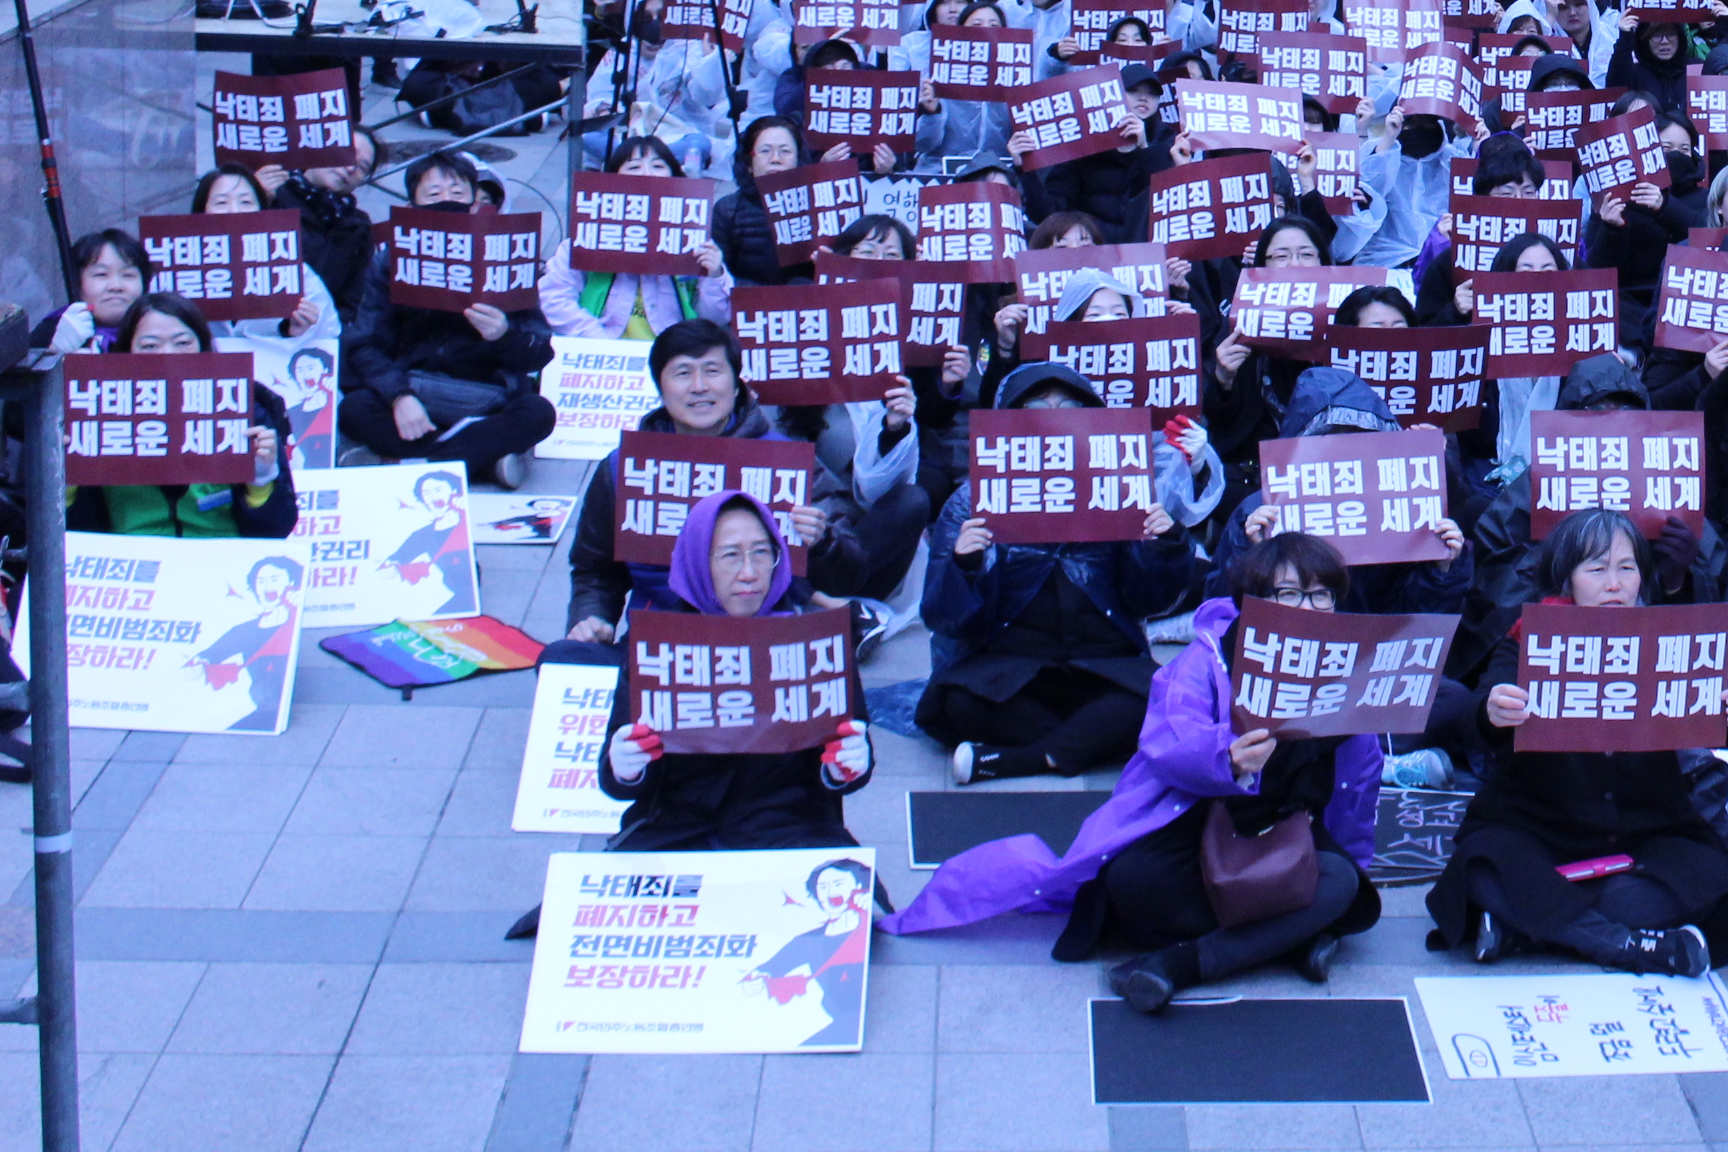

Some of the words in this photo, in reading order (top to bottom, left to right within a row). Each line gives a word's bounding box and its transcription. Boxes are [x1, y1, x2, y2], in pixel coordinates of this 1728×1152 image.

[932, 38, 988, 63] 낙태죄
[996, 41, 1031, 65] 폐지
[215, 89, 285, 123] 낙태죄
[295, 88, 347, 119] 폐지
[809, 85, 873, 110] 낙태죄
[881, 85, 917, 111] 폐지
[216, 124, 289, 154] 새로운
[298, 120, 351, 150] 세계
[575, 189, 649, 225] 낙태죄
[660, 193, 708, 225] 폐지
[145, 235, 231, 268] 낙태죄
[242, 230, 299, 263] 폐지
[393, 226, 473, 263] 낙태죄
[484, 229, 536, 260] 폐지
[572, 222, 648, 254] 새로운
[657, 225, 705, 255] 세계
[245, 266, 302, 298] 세계
[395, 260, 473, 294] 새로운
[484, 260, 534, 293] 세계
[735, 307, 827, 345] 낙태죄
[842, 303, 899, 340] 폐지
[740, 343, 830, 382] 새로운
[843, 339, 902, 377] 세계
[1145, 337, 1197, 373] 폐지
[67, 378, 168, 417] 낙태죄
[181, 377, 249, 415] 폐지
[1145, 373, 1198, 409] 세계
[67, 421, 168, 457] 새로운
[181, 419, 249, 456] 세계
[975, 434, 1073, 473] 낙태죄
[1088, 434, 1148, 470] 폐지
[1536, 437, 1629, 472] 낙태죄
[1644, 436, 1700, 471] 폐지
[1267, 457, 1365, 499] 낙태죄
[1377, 452, 1441, 491] 폐지
[976, 478, 1075, 515] 새로운
[1088, 475, 1152, 511] 세계
[1536, 477, 1631, 512] 새로운
[1644, 476, 1702, 512] 세계
[1272, 501, 1369, 538] 새로운
[1381, 495, 1443, 533] 세계
[67, 645, 156, 670] 장하라!
[637, 641, 752, 687] 낙태죄
[769, 635, 845, 677] 폐지
[1242, 627, 1356, 679] 낙태죄
[1371, 635, 1442, 674] 폐지
[1527, 636, 1638, 676] 낙태죄
[1656, 632, 1727, 673] 폐지
[637, 690, 755, 733] 새로운
[771, 678, 847, 723] 세계
[1235, 673, 1349, 718] 새로운
[1358, 673, 1437, 707] 세계
[1527, 680, 1636, 720] 새로운
[1651, 677, 1724, 716] 세계
[579, 874, 704, 899] 낙태죄를
[572, 904, 699, 929] 폐지하고
[569, 933, 758, 960] 전면비범죄화
[563, 964, 707, 989] 보장하라!
